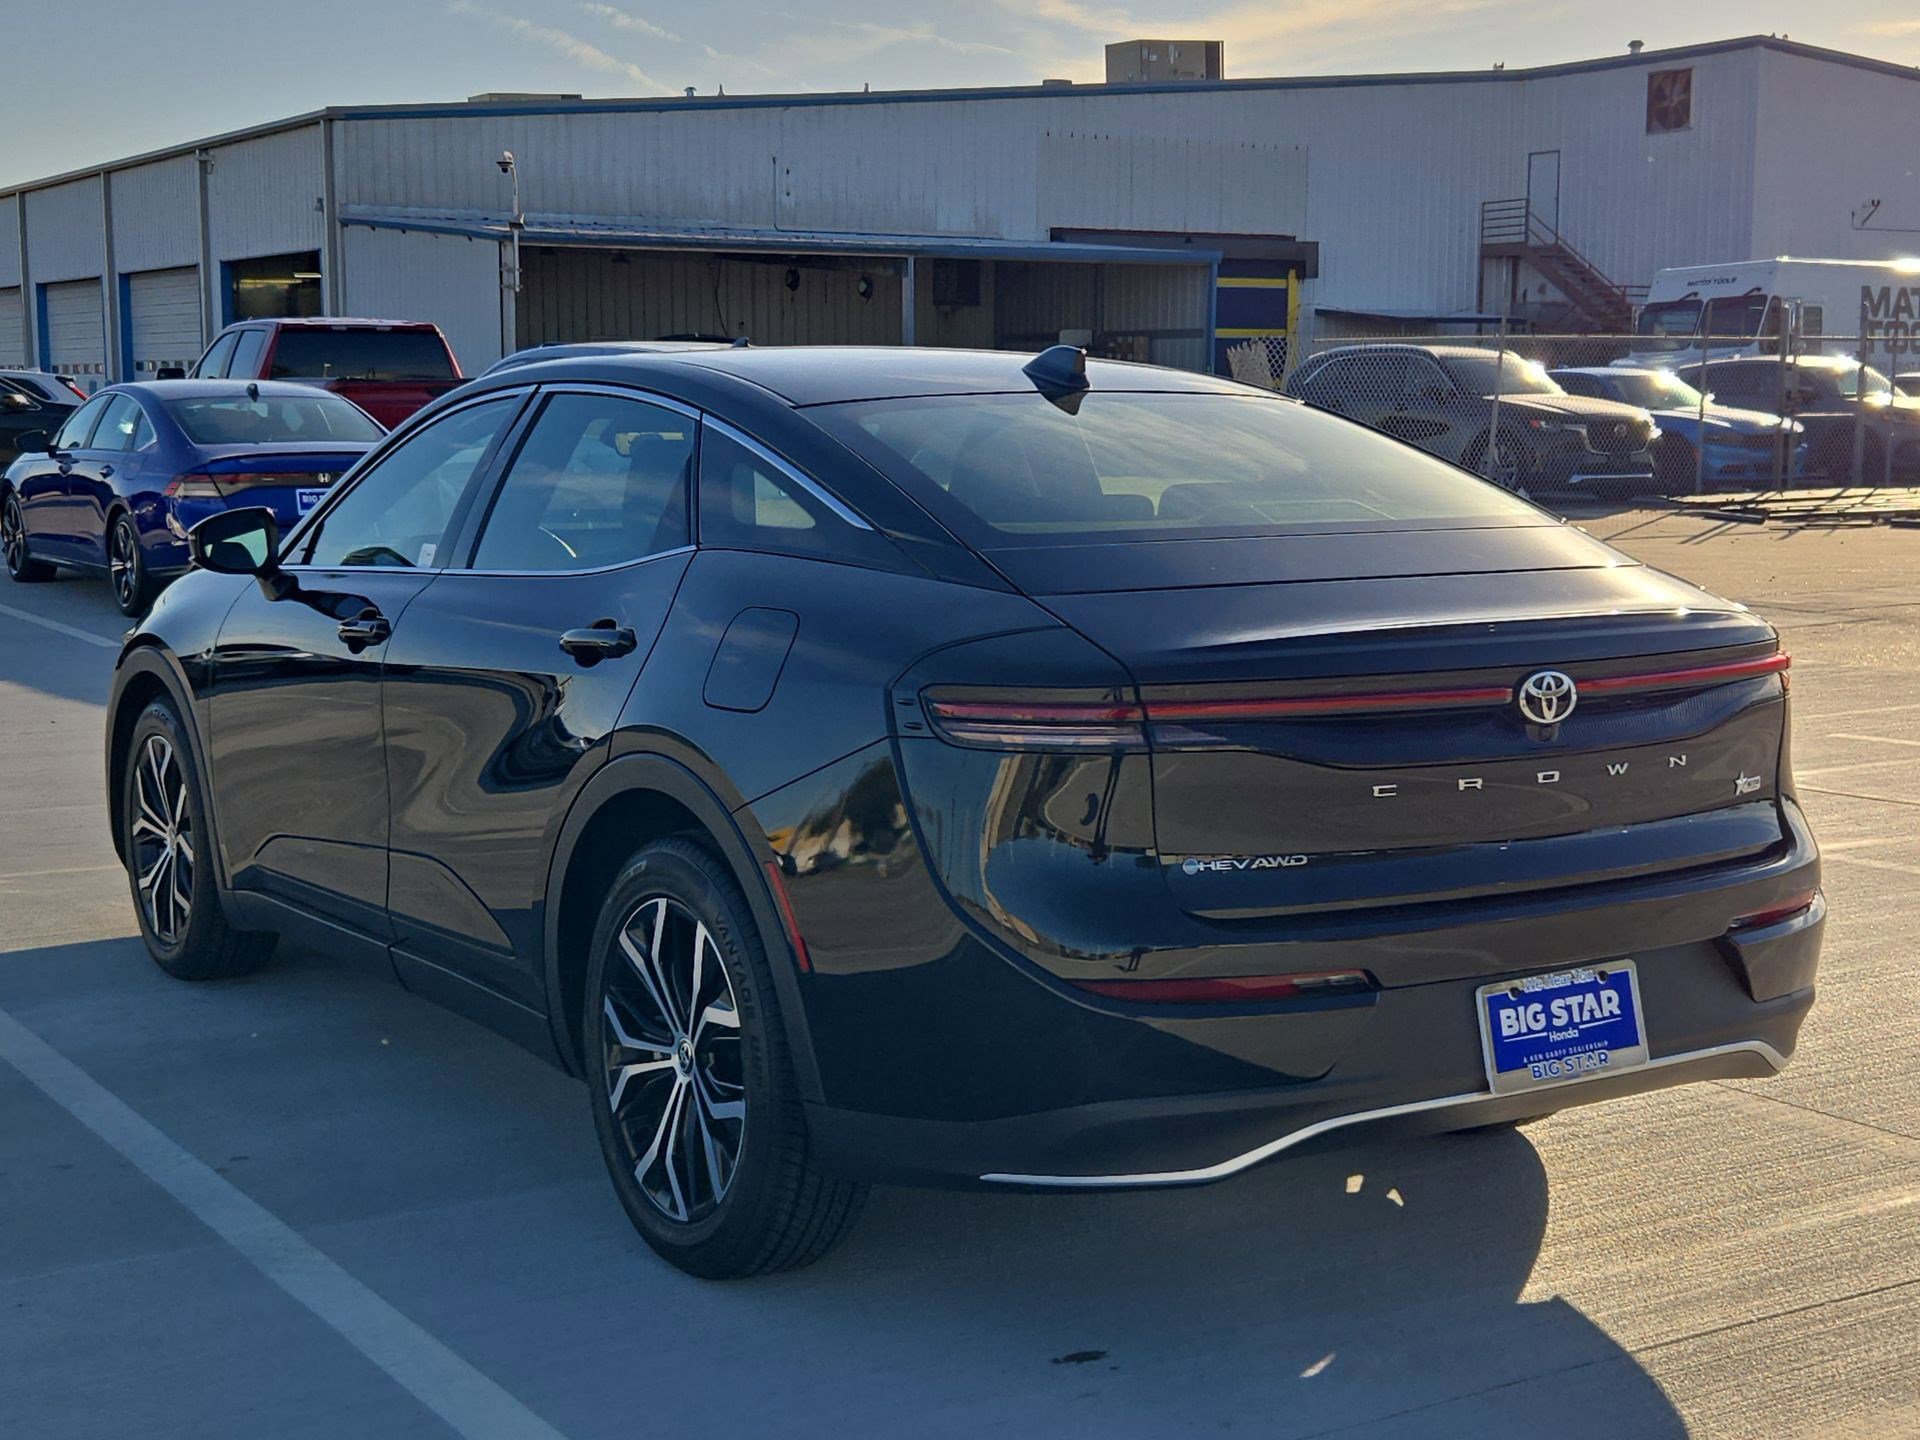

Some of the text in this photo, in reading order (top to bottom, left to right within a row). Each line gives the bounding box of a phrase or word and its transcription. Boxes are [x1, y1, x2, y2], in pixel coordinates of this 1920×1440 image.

[1372, 753, 1687, 798] CROWN
[1500, 989, 1621, 1037] BIG STAR
[1549, 1028, 1579, 1043] Honda
[1531, 1051, 1609, 1079] BIG STAR
